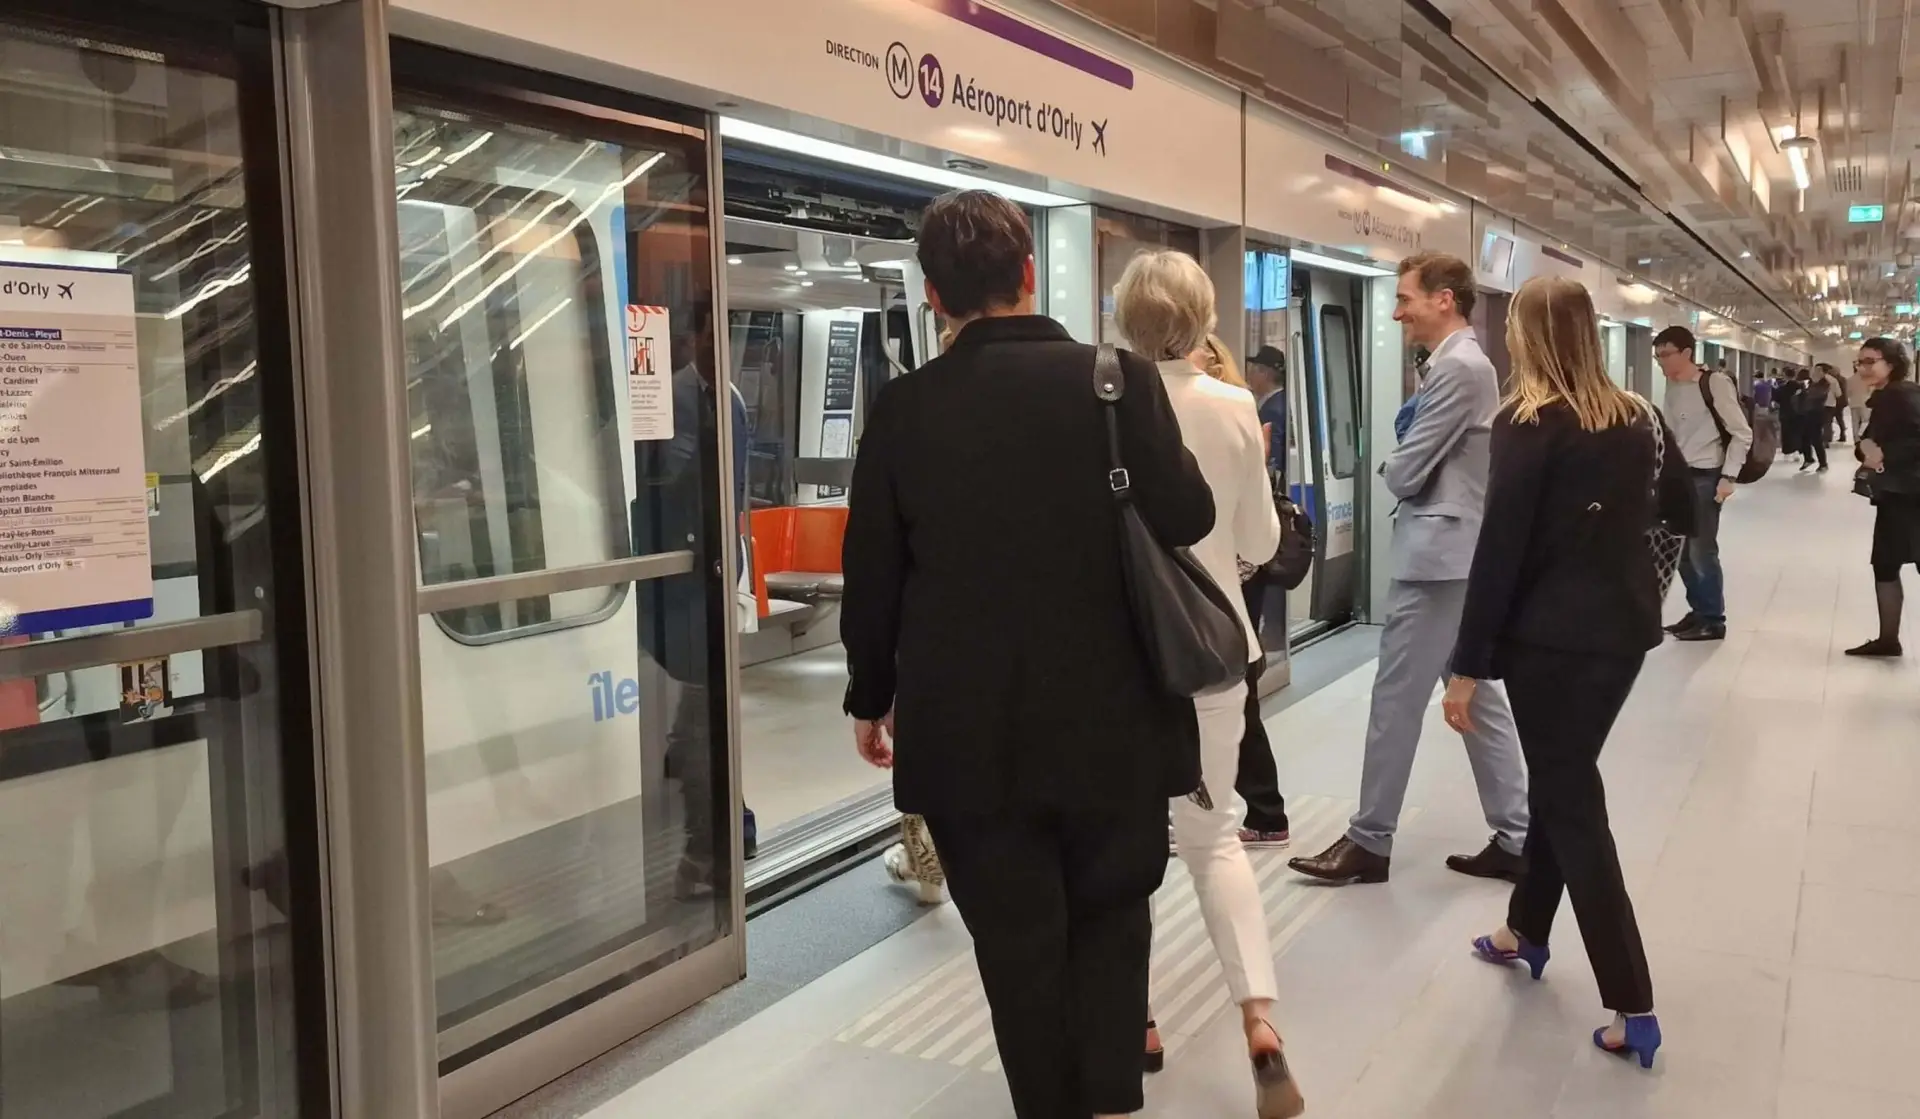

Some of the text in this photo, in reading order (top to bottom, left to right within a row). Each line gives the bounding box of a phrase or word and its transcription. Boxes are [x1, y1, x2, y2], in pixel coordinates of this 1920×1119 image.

[825, 39, 879, 70] DIRECTION
[921, 63, 942, 99] 14
[951, 73, 1033, 129] Aéroport
[1036, 102, 1083, 151] d'Orly
[3, 280, 50, 300] d'Orly
[35, 330, 60, 339] Pleyel
[8, 342, 19, 350] de
[21, 342, 66, 350] Saint-Ouen
[5, 365, 17, 373] de
[18, 365, 43, 375] Clichy
[3, 376, 38, 385] Cardinet
[7, 436, 19, 445] de
[20, 436, 40, 446] Lyon
[43, 469, 77, 479] François
[79, 467, 120, 476] Mitterrand
[22, 493, 56, 502] Blanche
[24, 505, 53, 513] Bicêtre
[37, 561, 62, 571] d'Orly
[587, 670, 639, 723] île
